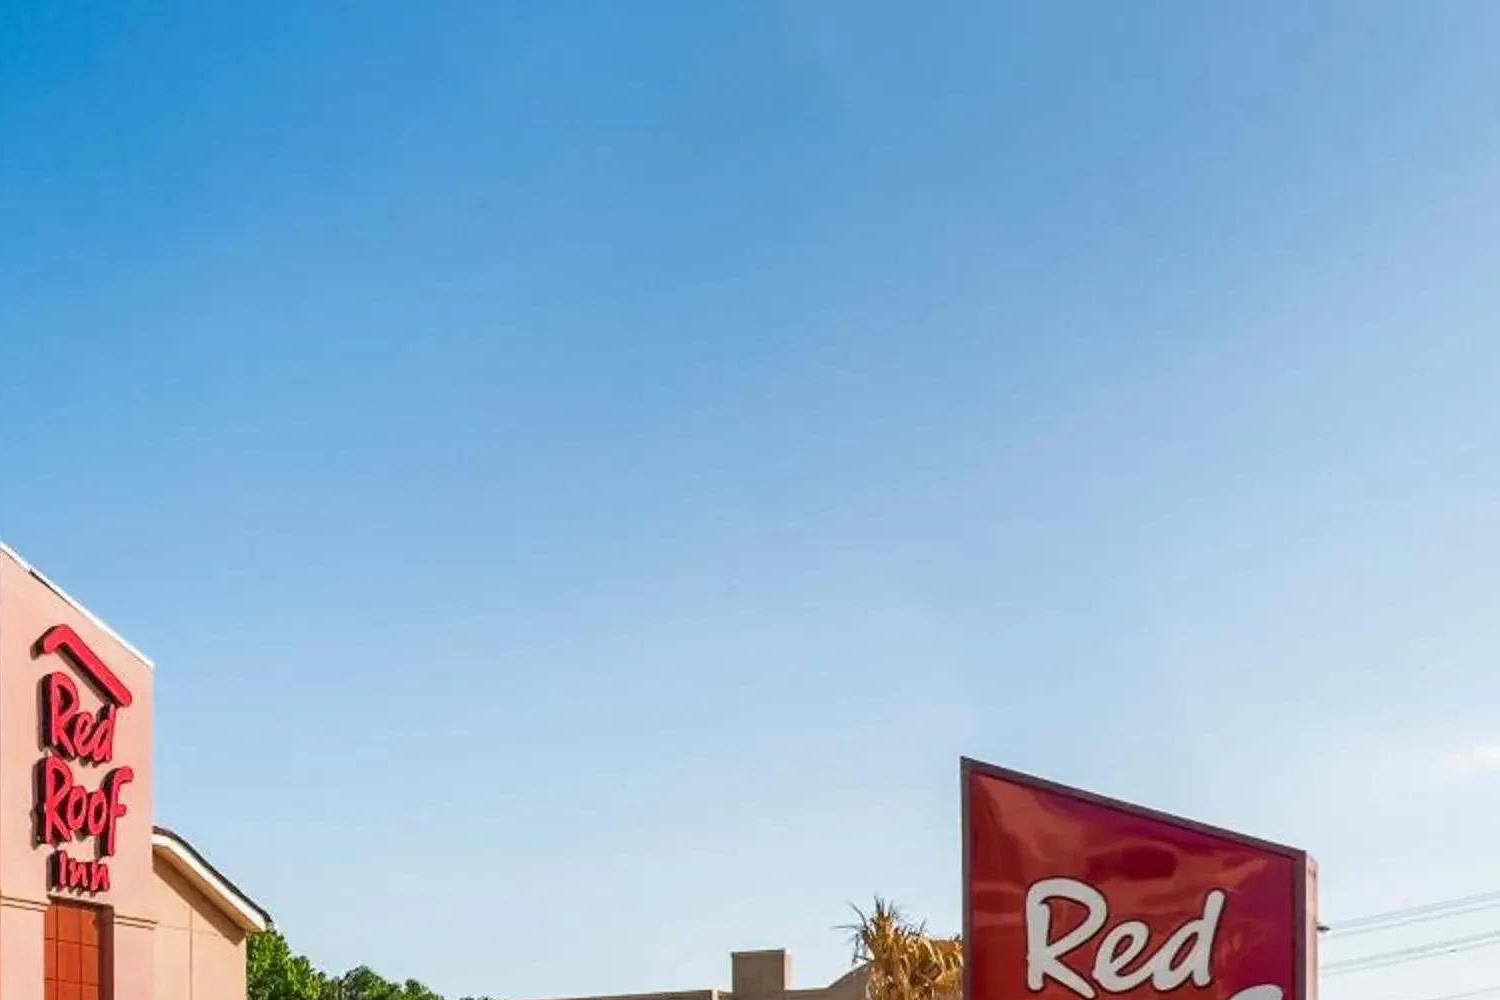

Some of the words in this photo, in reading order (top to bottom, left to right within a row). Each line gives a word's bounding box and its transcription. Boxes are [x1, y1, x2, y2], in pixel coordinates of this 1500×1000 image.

[48, 671, 117, 763] Red
[43, 755, 135, 857] Roof
[56, 850, 111, 893] Inn
[1025, 876, 1226, 1000] Red
